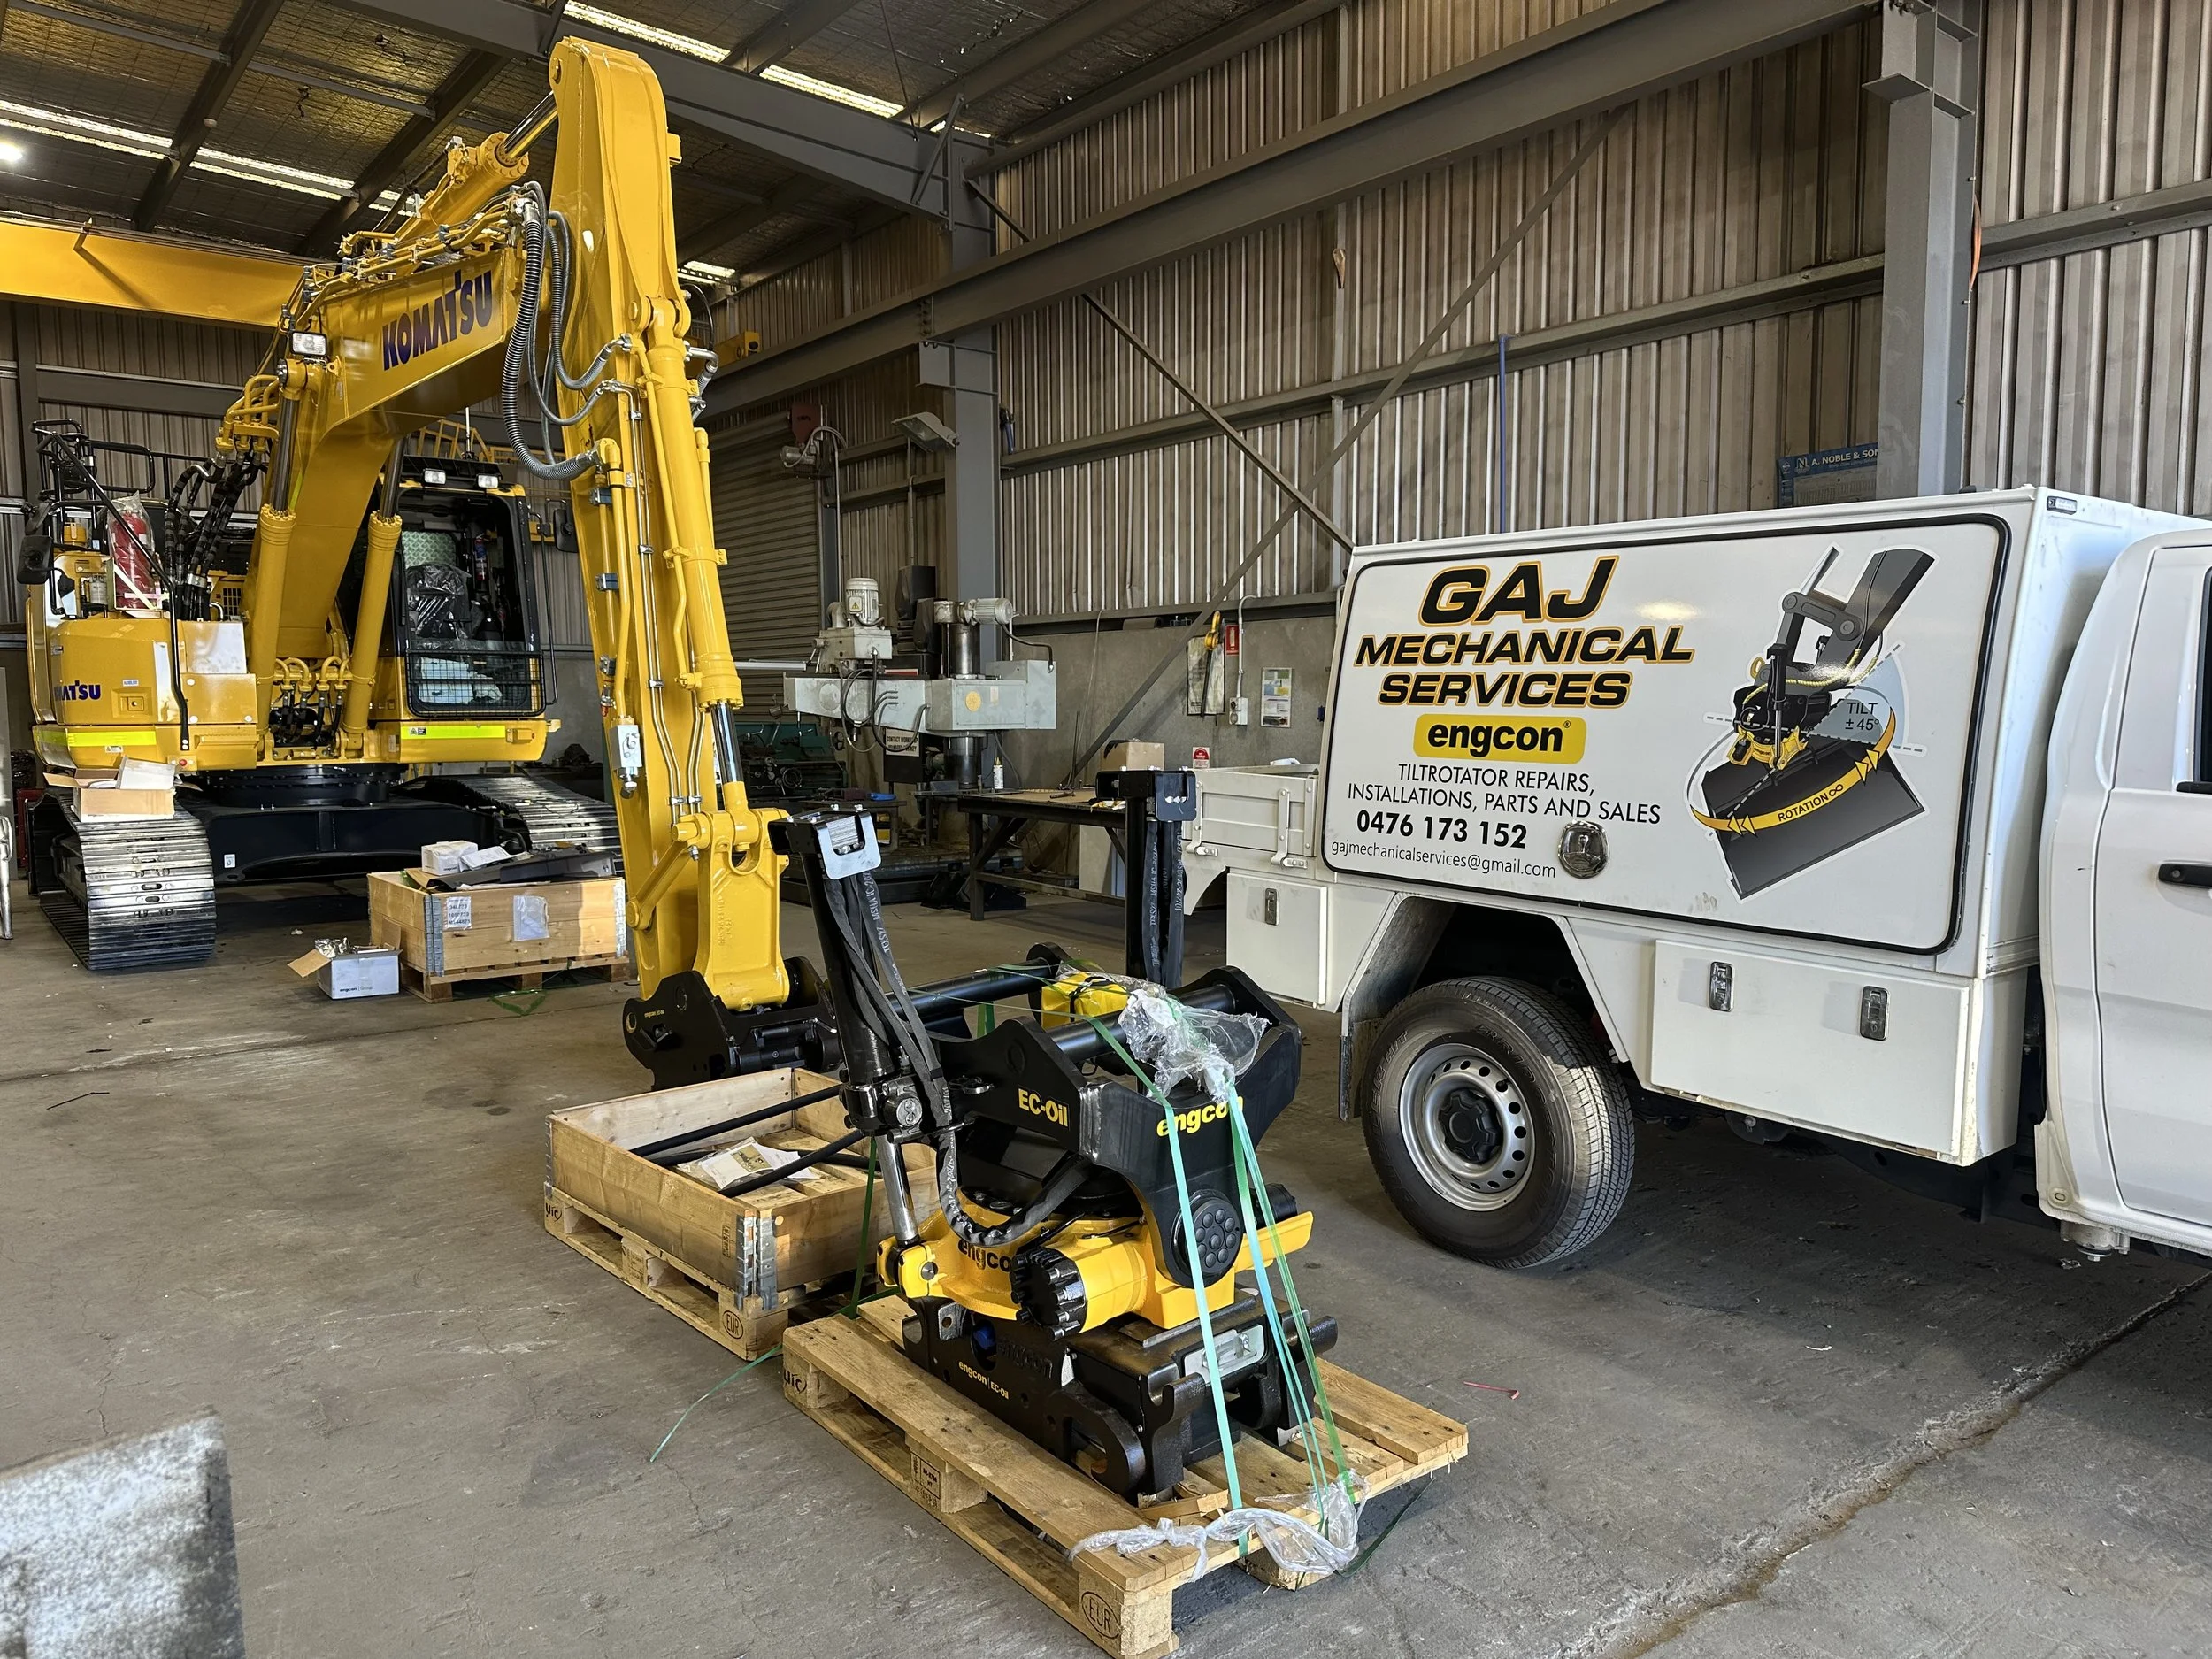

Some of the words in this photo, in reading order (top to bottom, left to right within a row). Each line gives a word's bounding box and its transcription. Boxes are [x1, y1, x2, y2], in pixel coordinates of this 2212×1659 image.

[382, 269, 492, 371] KOMATSU
[1823, 453, 1851, 465] NOBLE
[1418, 555, 1620, 627] GAJ
[1353, 625, 1695, 667] MECHANICAL
[1378, 670, 1633, 709] SERVICES
[1847, 703, 1878, 715] TILT
[1398, 764, 1509, 787] TILTROTATOR
[1514, 770, 1595, 797] REPAIRS,
[1348, 783, 1478, 812] INSTALLATIONS,
[1484, 794, 1538, 815] PARTS
[1544, 798, 1591, 818] AND
[1599, 801, 1662, 825] SALES
[1778, 792, 1829, 822] ROTATION
[1356, 810, 1414, 837] 0476
[1423, 817, 1468, 842] 173
[1479, 821, 1527, 849] 152
[1331, 841, 1556, 879] gajmechanicalservices@gmail.com
[1018, 1088, 1069, 1127] EC-Oil
[726, 1314, 740, 1335] EUR
[958, 1361, 987, 1386] engcon
[990, 1381, 1009, 1400] EC-Oil
[1090, 1596, 1111, 1634] EUR
